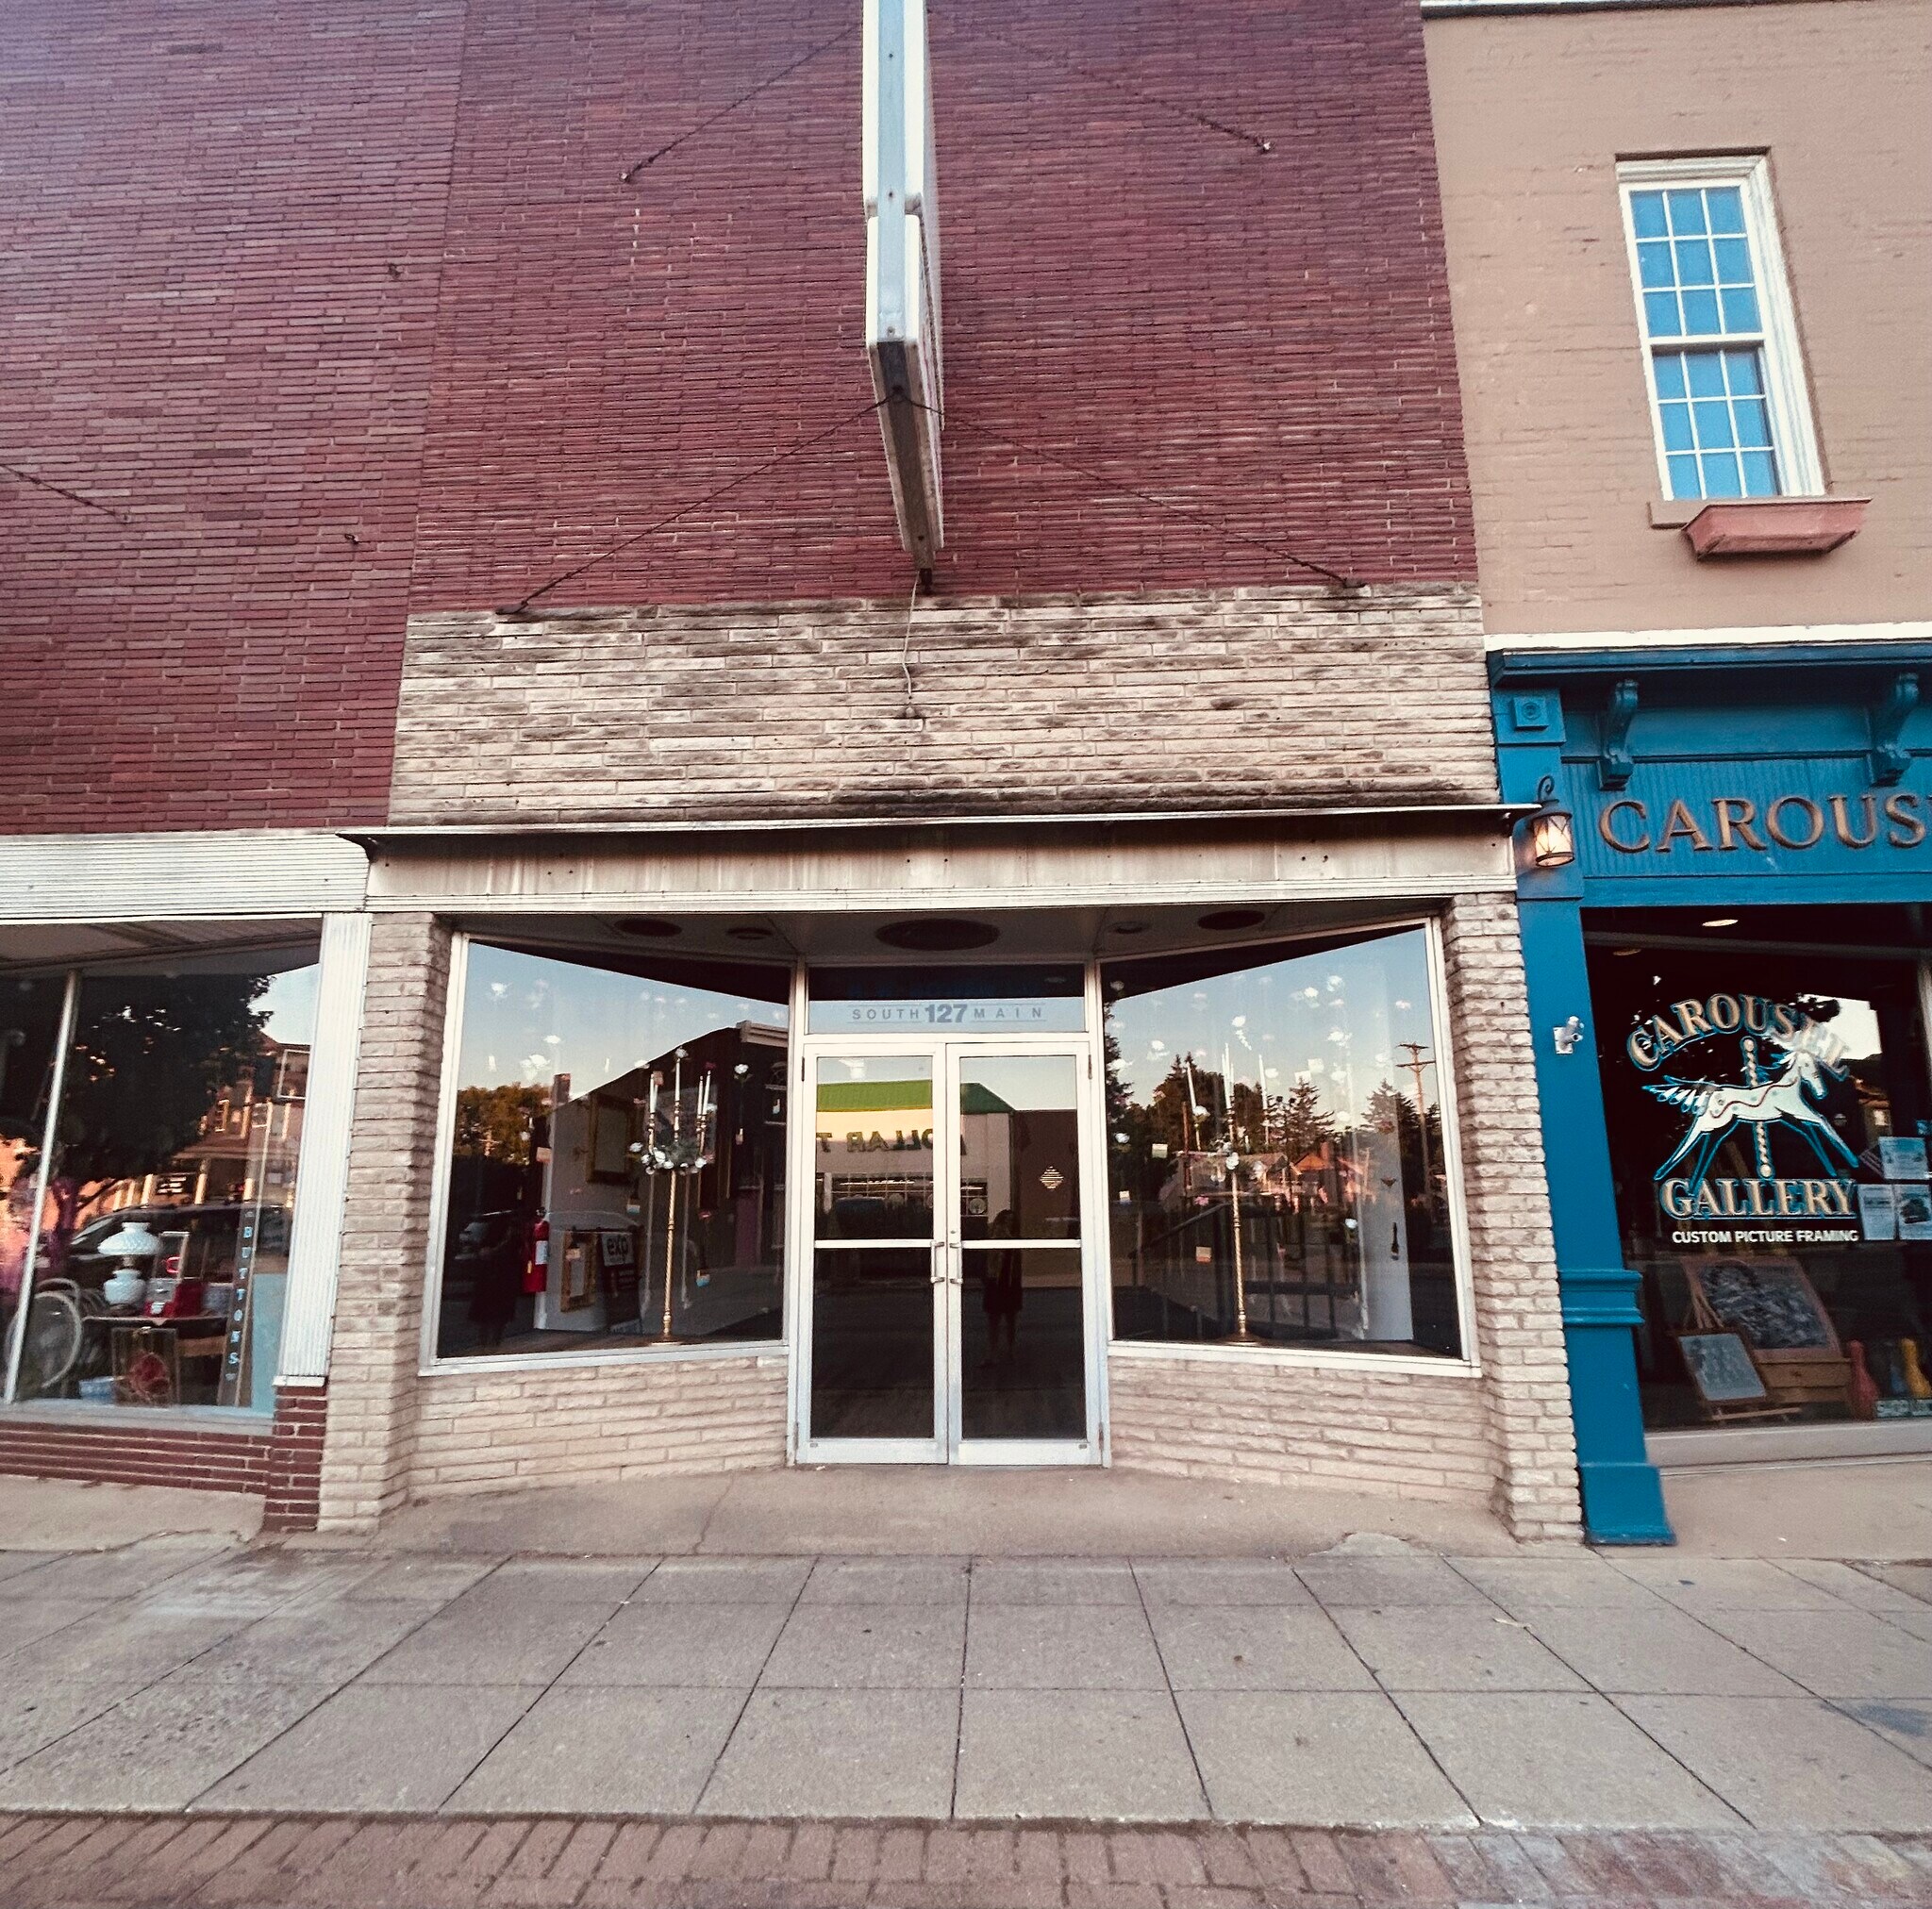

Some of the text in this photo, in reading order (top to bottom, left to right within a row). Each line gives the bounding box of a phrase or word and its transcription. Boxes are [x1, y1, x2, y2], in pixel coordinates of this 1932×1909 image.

[1598, 793, 1932, 855] CAROUS
[852, 1004, 1042, 1023] SOUTH 127 MAIN
[1659, 1178, 1857, 1220] GALLERY
[1672, 1229, 1859, 1243] CUSTOM PICTURE FRAMING
